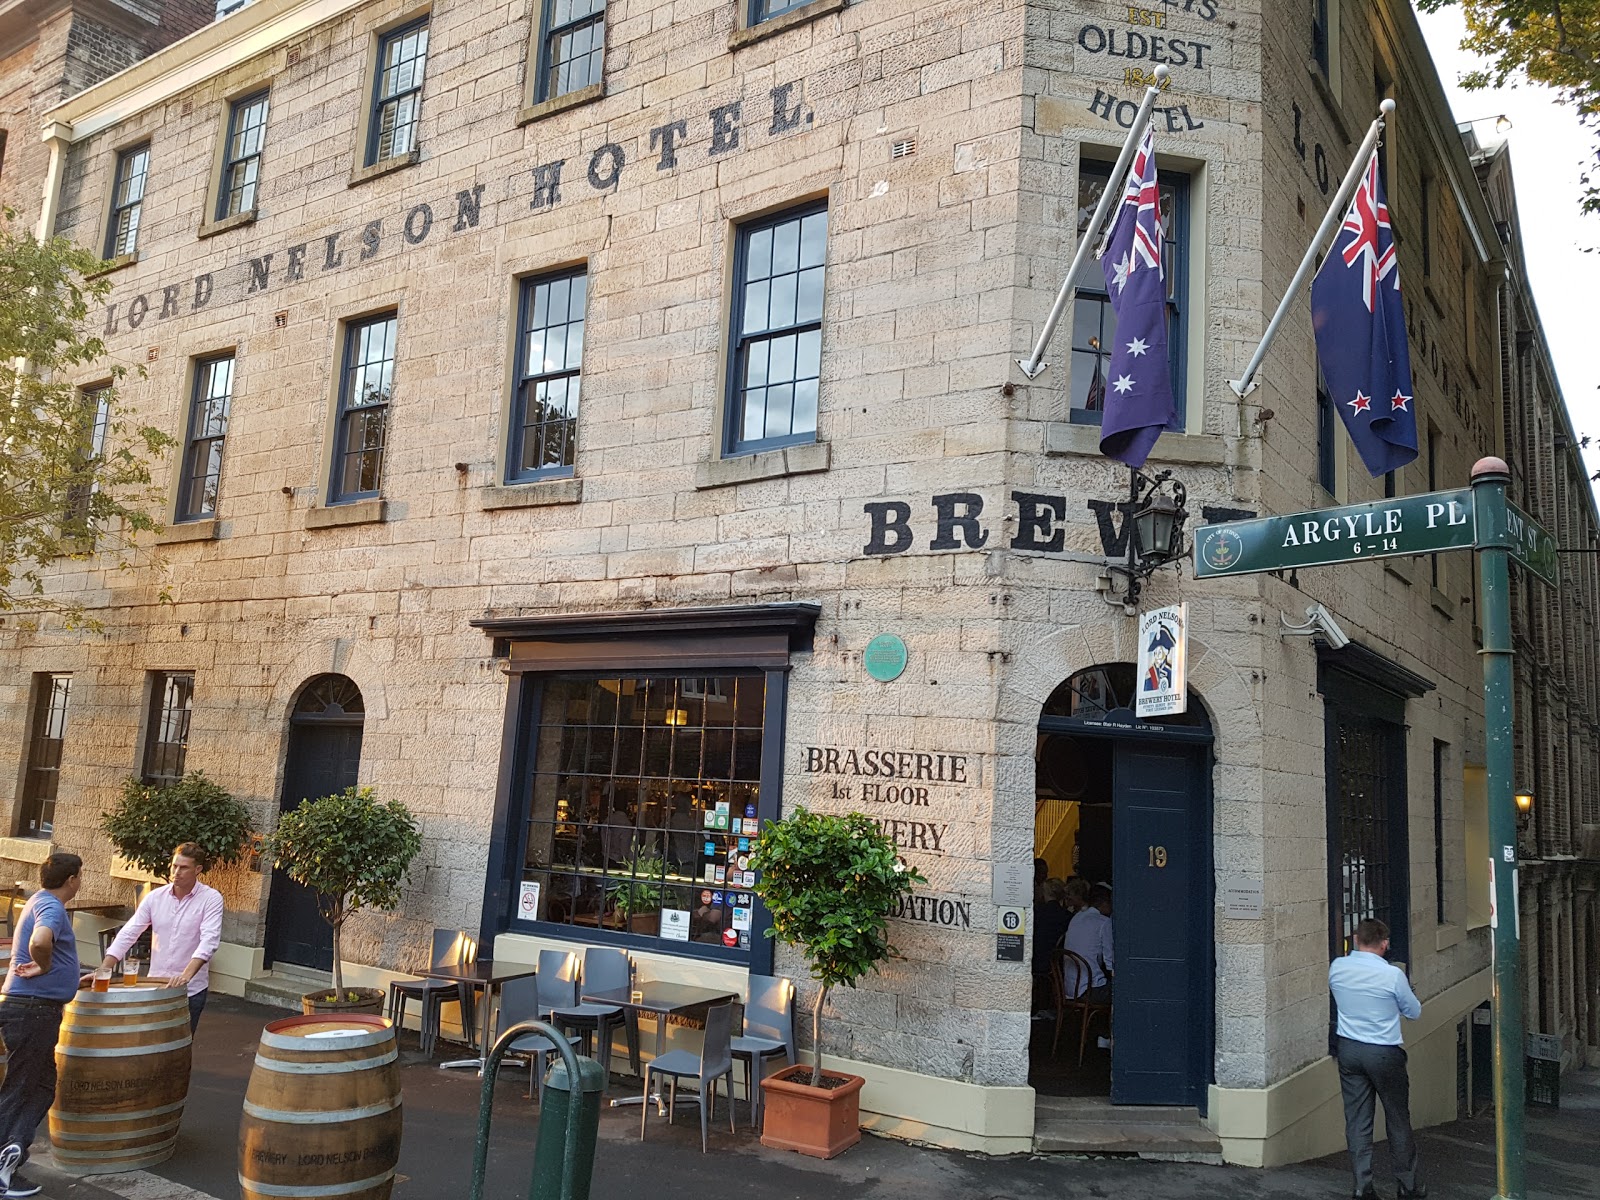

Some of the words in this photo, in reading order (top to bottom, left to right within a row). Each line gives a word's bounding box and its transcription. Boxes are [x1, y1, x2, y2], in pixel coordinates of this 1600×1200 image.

[1127, 6, 1166, 29] EST.
[1078, 24, 1211, 69] OLDEST
[103, 273, 213, 337] LORD
[248, 184, 486, 295] NELSON
[1281, 508, 1403, 548] ARGYLE
[1426, 501, 1467, 529] PL
[1506, 508, 1524, 541] ENT
[1528, 526, 1537, 552] ST
[1353, 541, 1361, 554] 6
[1383, 538, 1398, 551] 14
[1141, 615, 1157, 635] LORD
[1158, 611, 1184, 629] NELSON
[1164, 693, 1181, 703] HOTEL
[805, 747, 967, 783] BRASSERIE
[832, 782, 851, 800] 1st
[861, 783, 929, 806] FLOOR
[1149, 846, 1167, 867] 19
[1006, 917, 1016, 928] 18
[298, 1153, 324, 1166] LORD
[326, 1150, 362, 1165] NELSON
